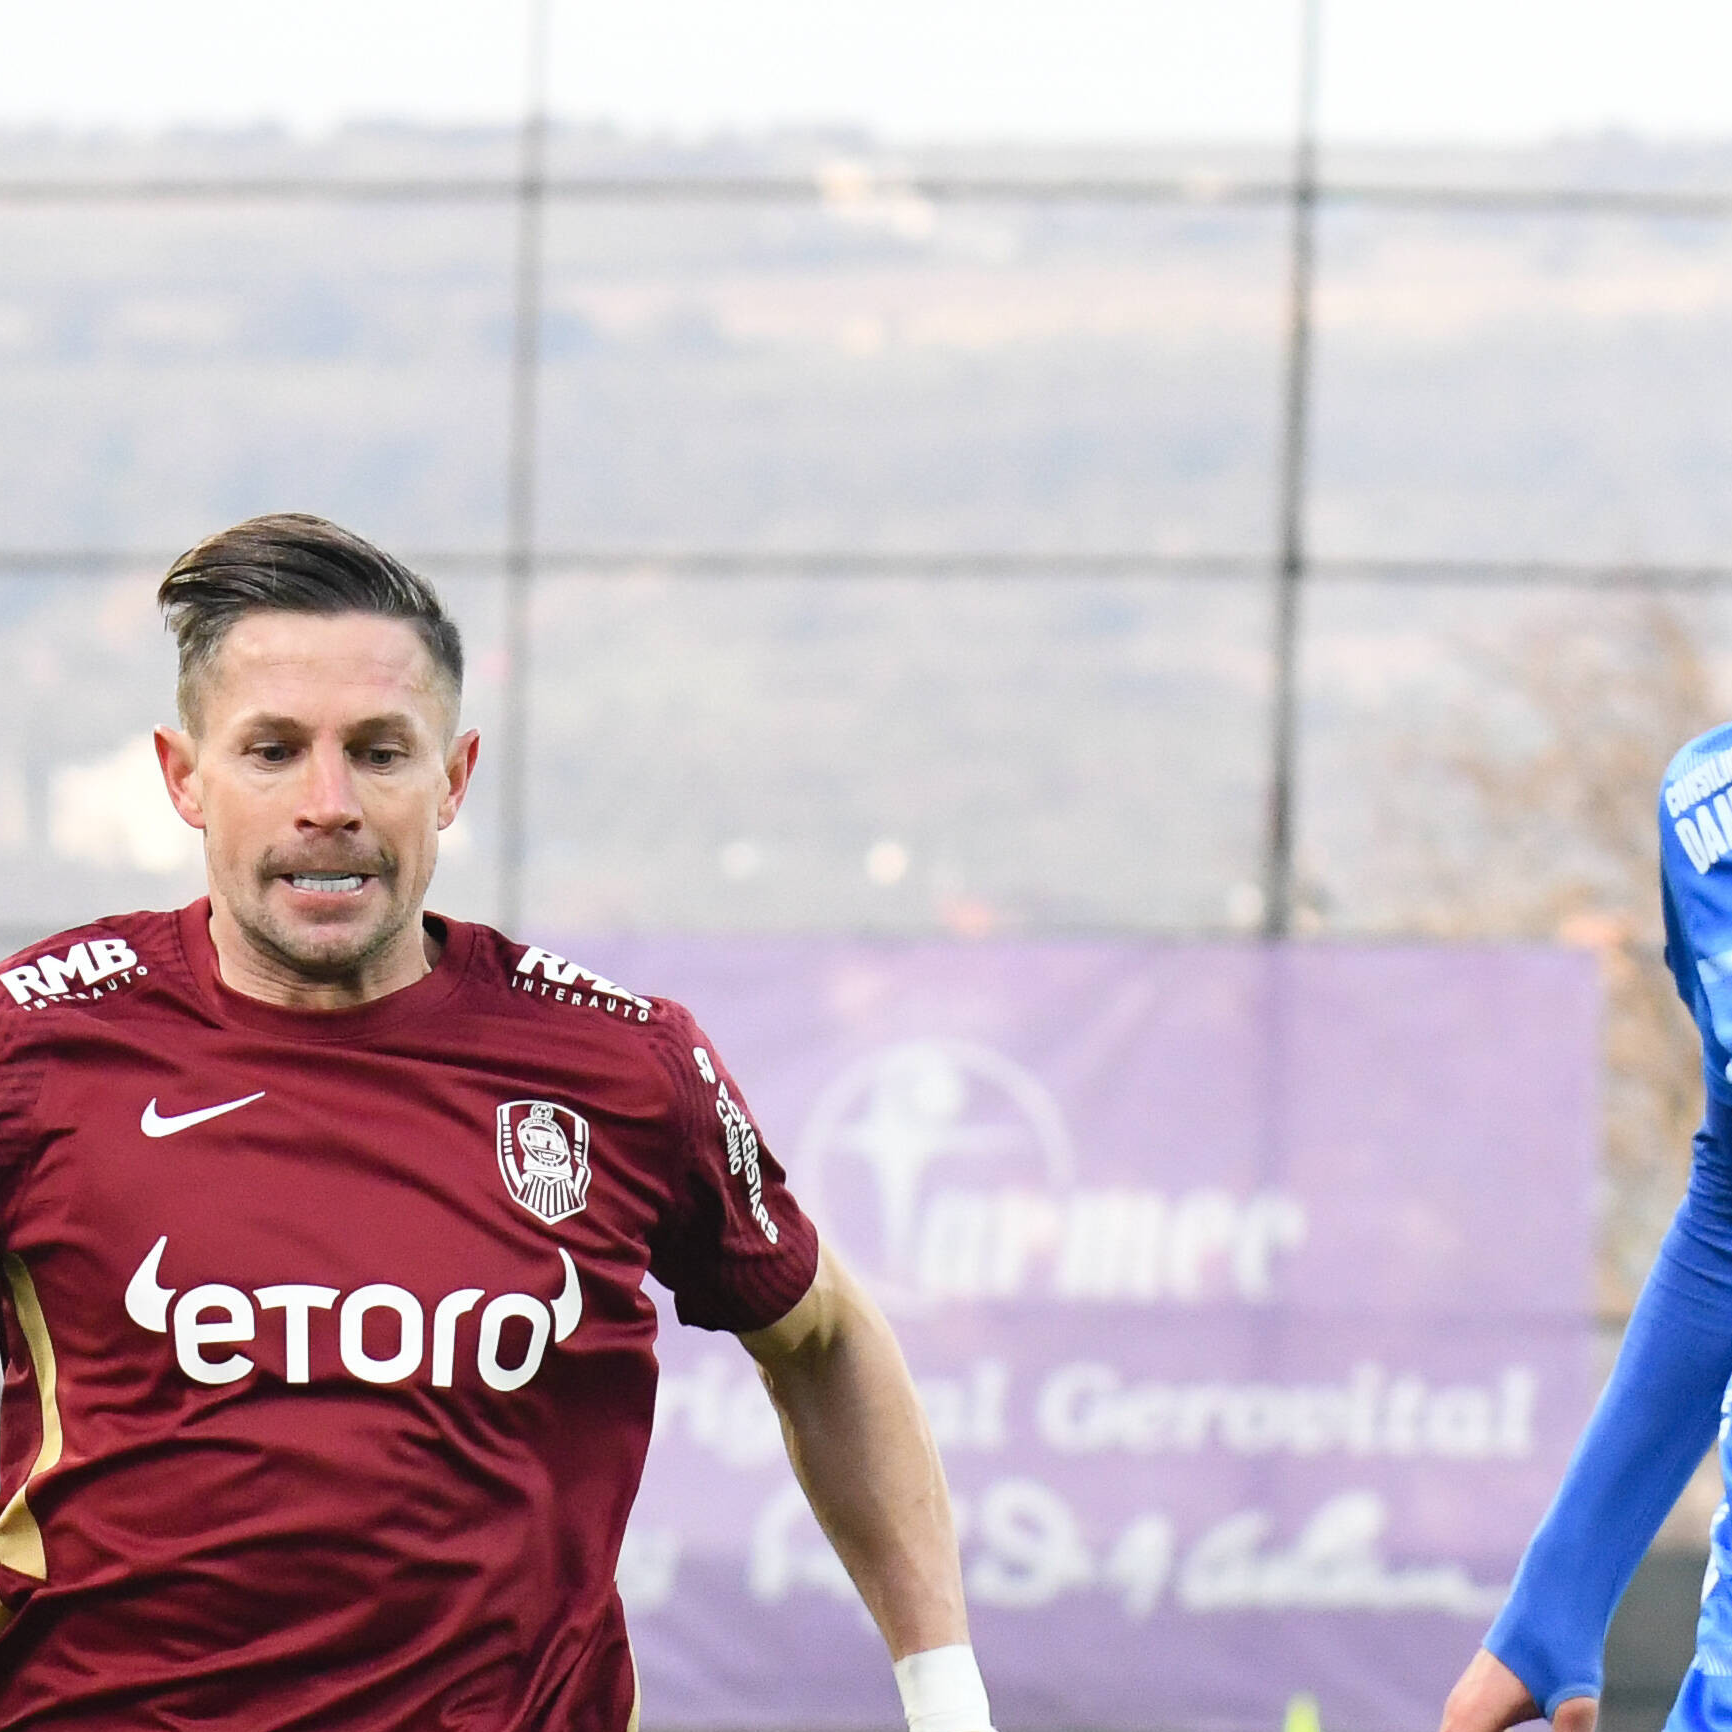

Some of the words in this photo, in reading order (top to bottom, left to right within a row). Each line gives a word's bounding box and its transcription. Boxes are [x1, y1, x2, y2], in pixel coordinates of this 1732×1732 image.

[0, 939, 138, 1005] RMB
[512, 976, 649, 1022] INTERAUTO
[716, 1100, 742, 1175] CASINO
[719, 1080, 779, 1244] POKERSTARS
